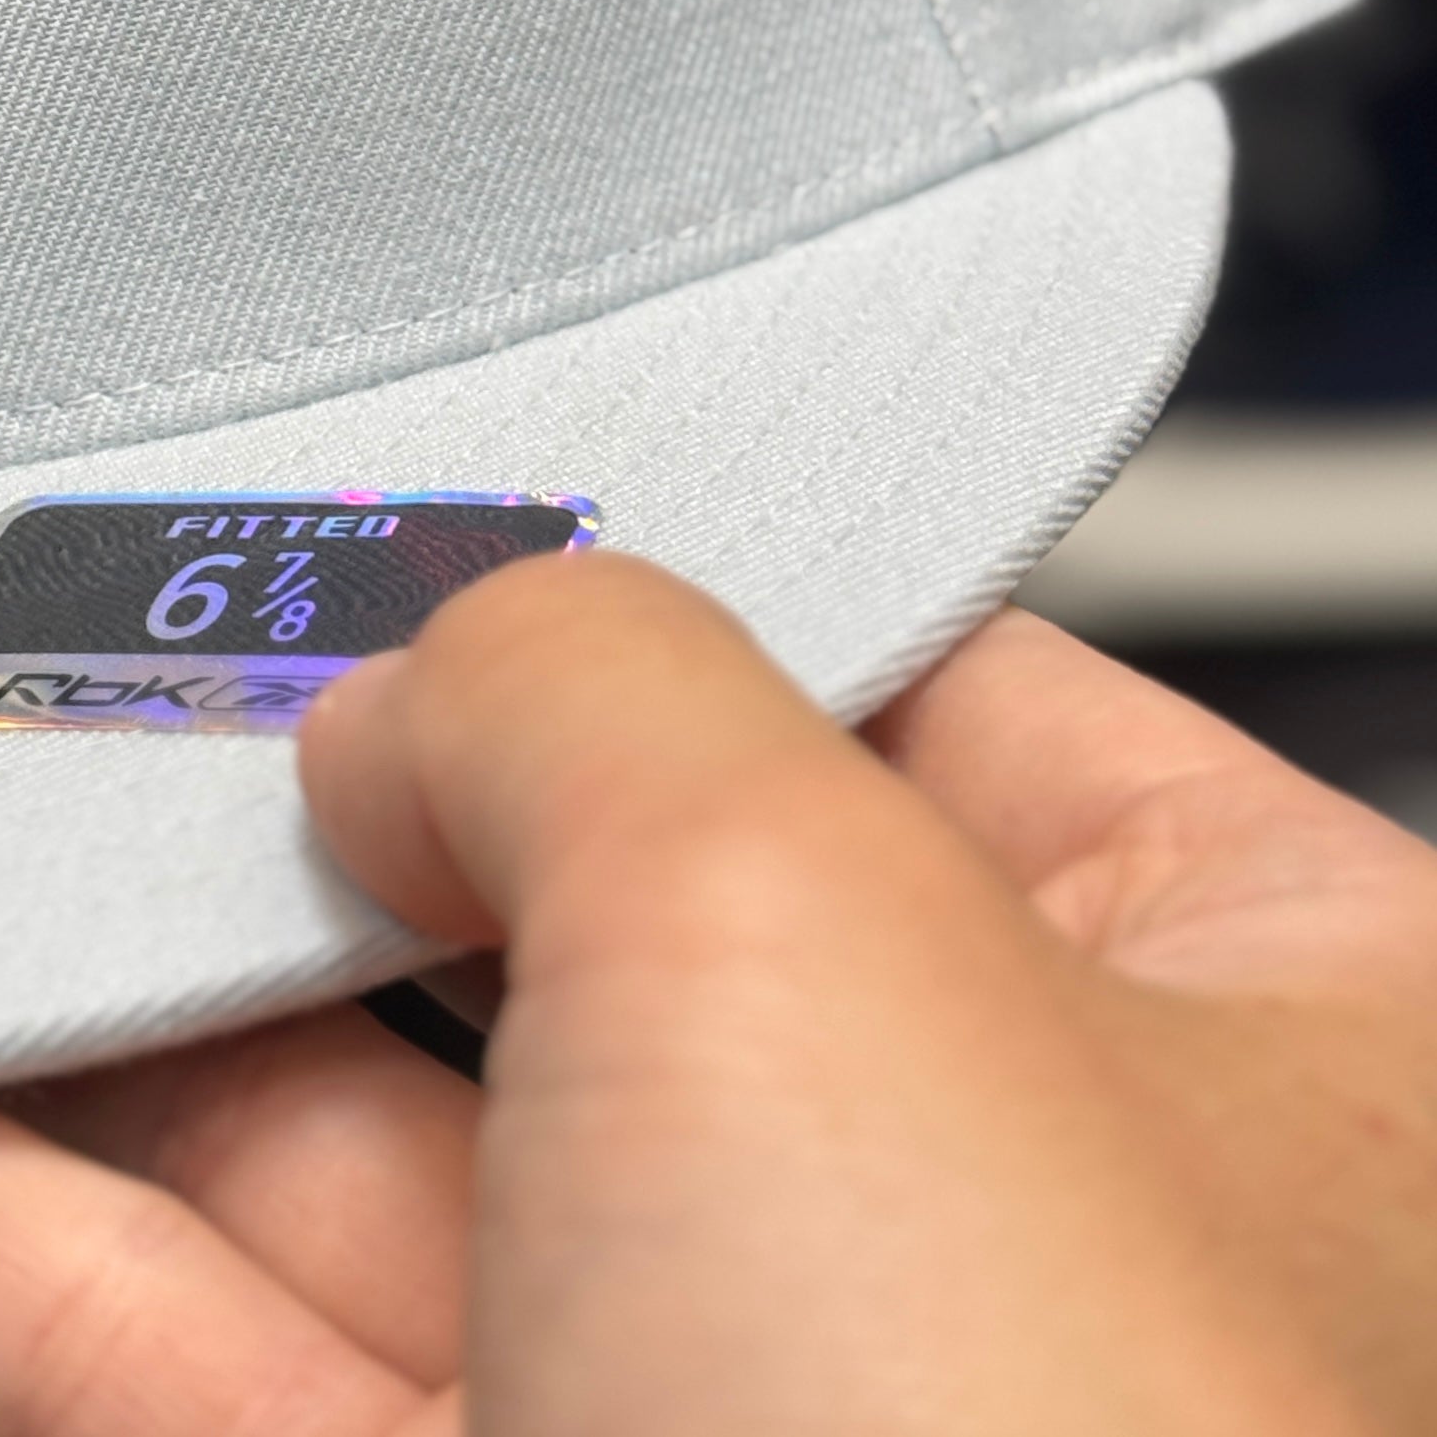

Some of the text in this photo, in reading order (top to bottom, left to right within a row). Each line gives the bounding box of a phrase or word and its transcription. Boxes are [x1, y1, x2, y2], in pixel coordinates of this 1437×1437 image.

[164, 515, 401, 539] FITTED
[145, 551, 320, 643] 6 7/8
